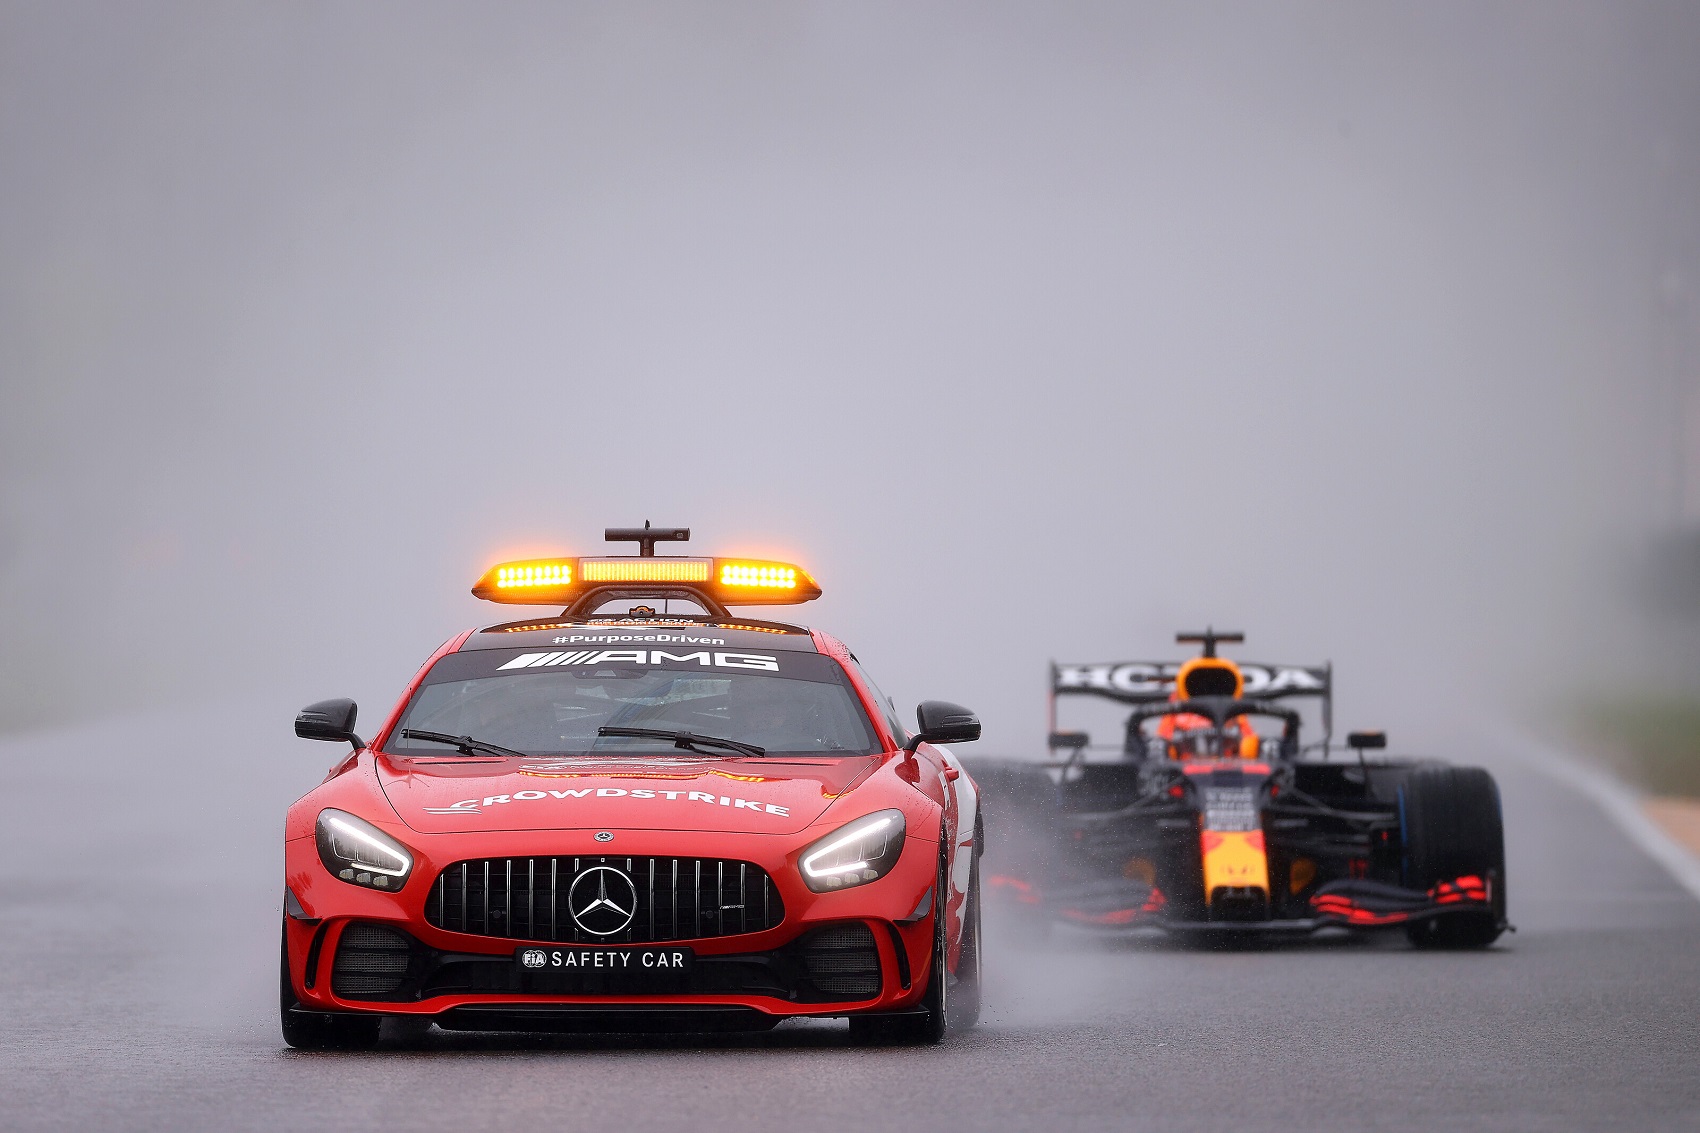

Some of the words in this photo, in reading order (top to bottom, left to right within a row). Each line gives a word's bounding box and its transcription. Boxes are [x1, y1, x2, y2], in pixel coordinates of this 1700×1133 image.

[552, 634, 725, 646] #PurposeDriven
[448, 788, 790, 818] CROWDSTRIKE
[551, 951, 632, 968] SAFETY
[642, 951, 684, 968] CAR
